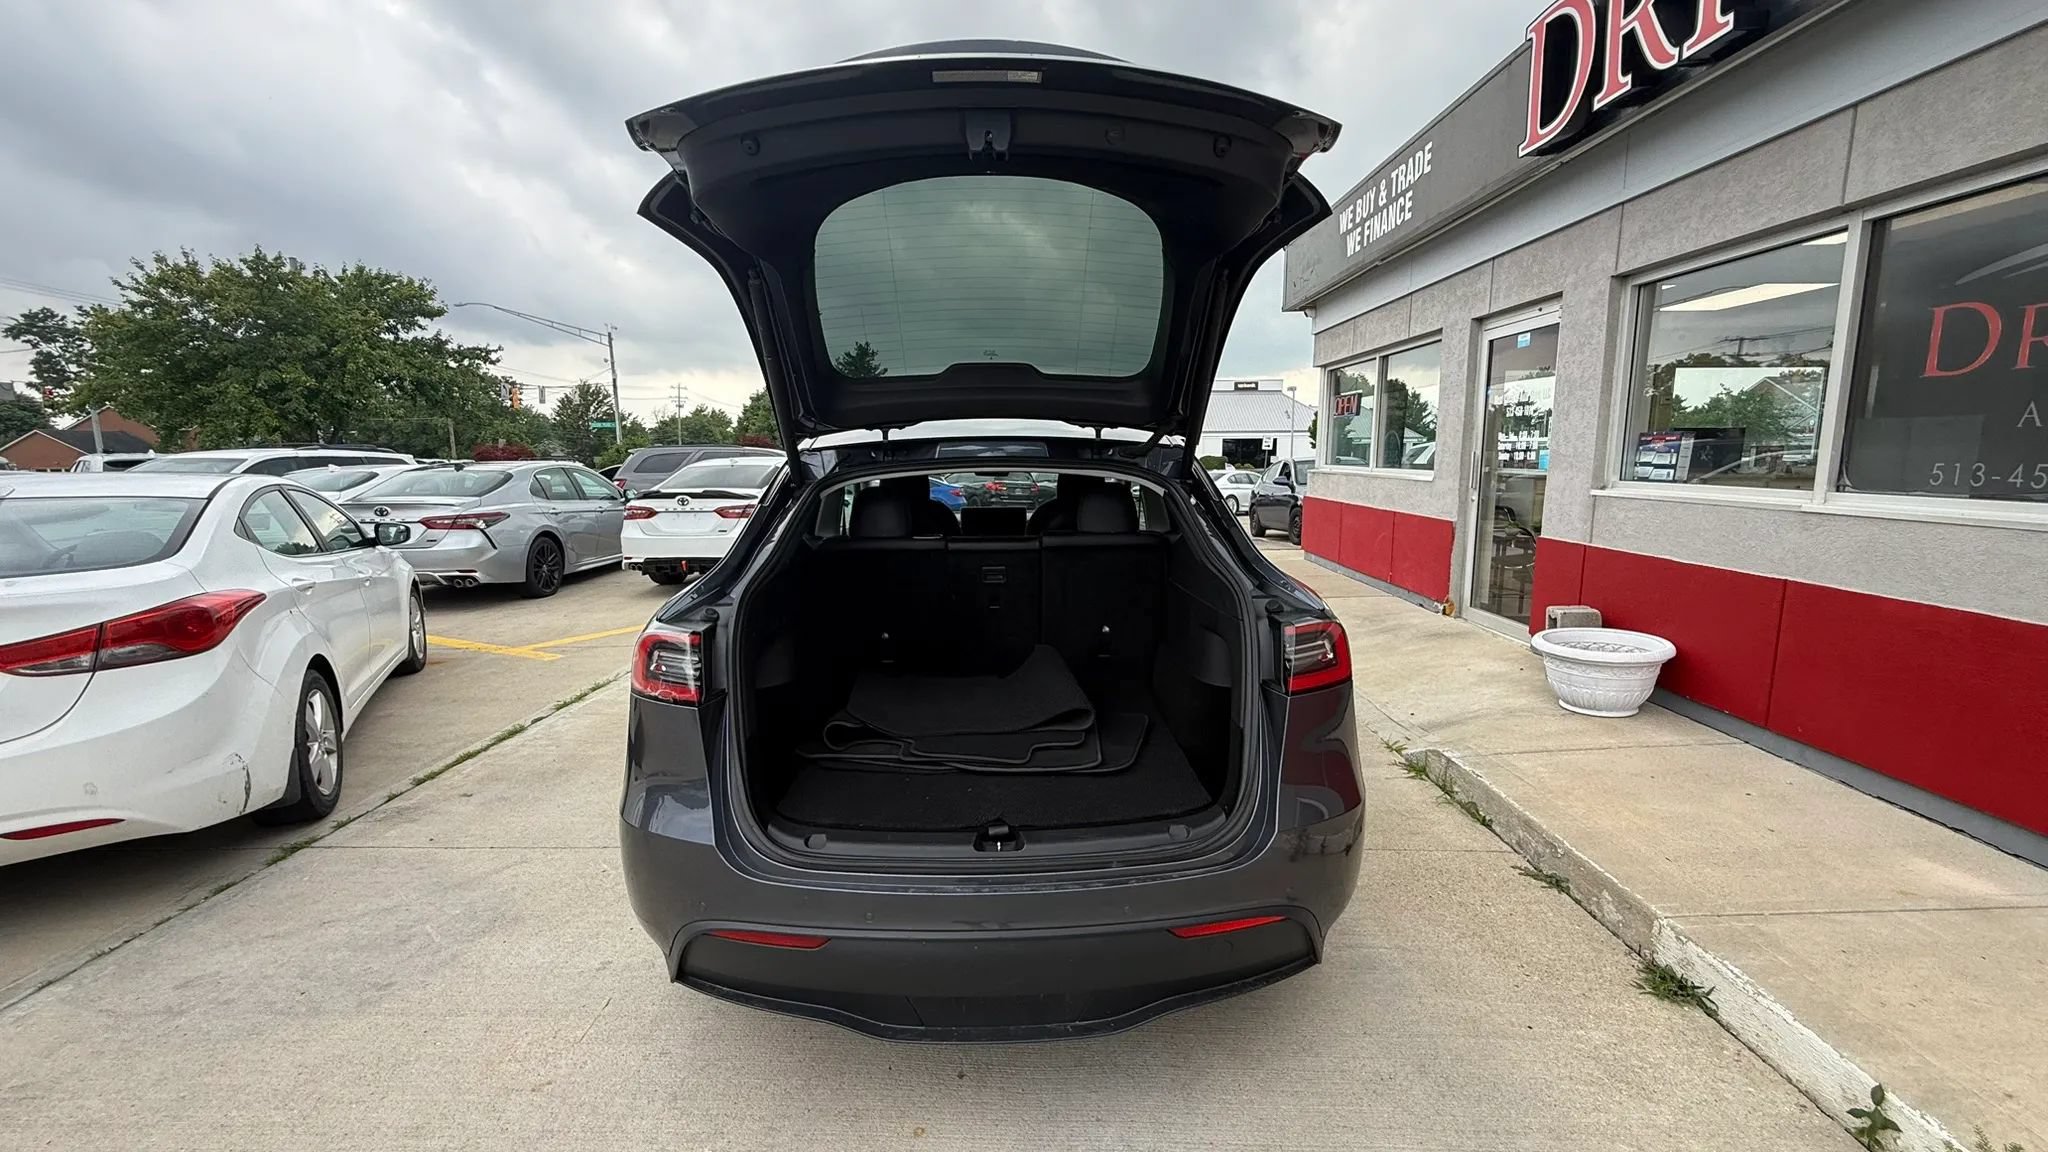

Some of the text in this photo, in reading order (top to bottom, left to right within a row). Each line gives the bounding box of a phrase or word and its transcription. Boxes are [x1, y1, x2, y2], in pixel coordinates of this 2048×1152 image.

[1340, 141, 1433, 235] WE BUY & TRADE
[1346, 190, 1413, 257] WE FINANCE
[1335, 393, 1357, 415] OPEN
[2016, 400, 2043, 427] A
